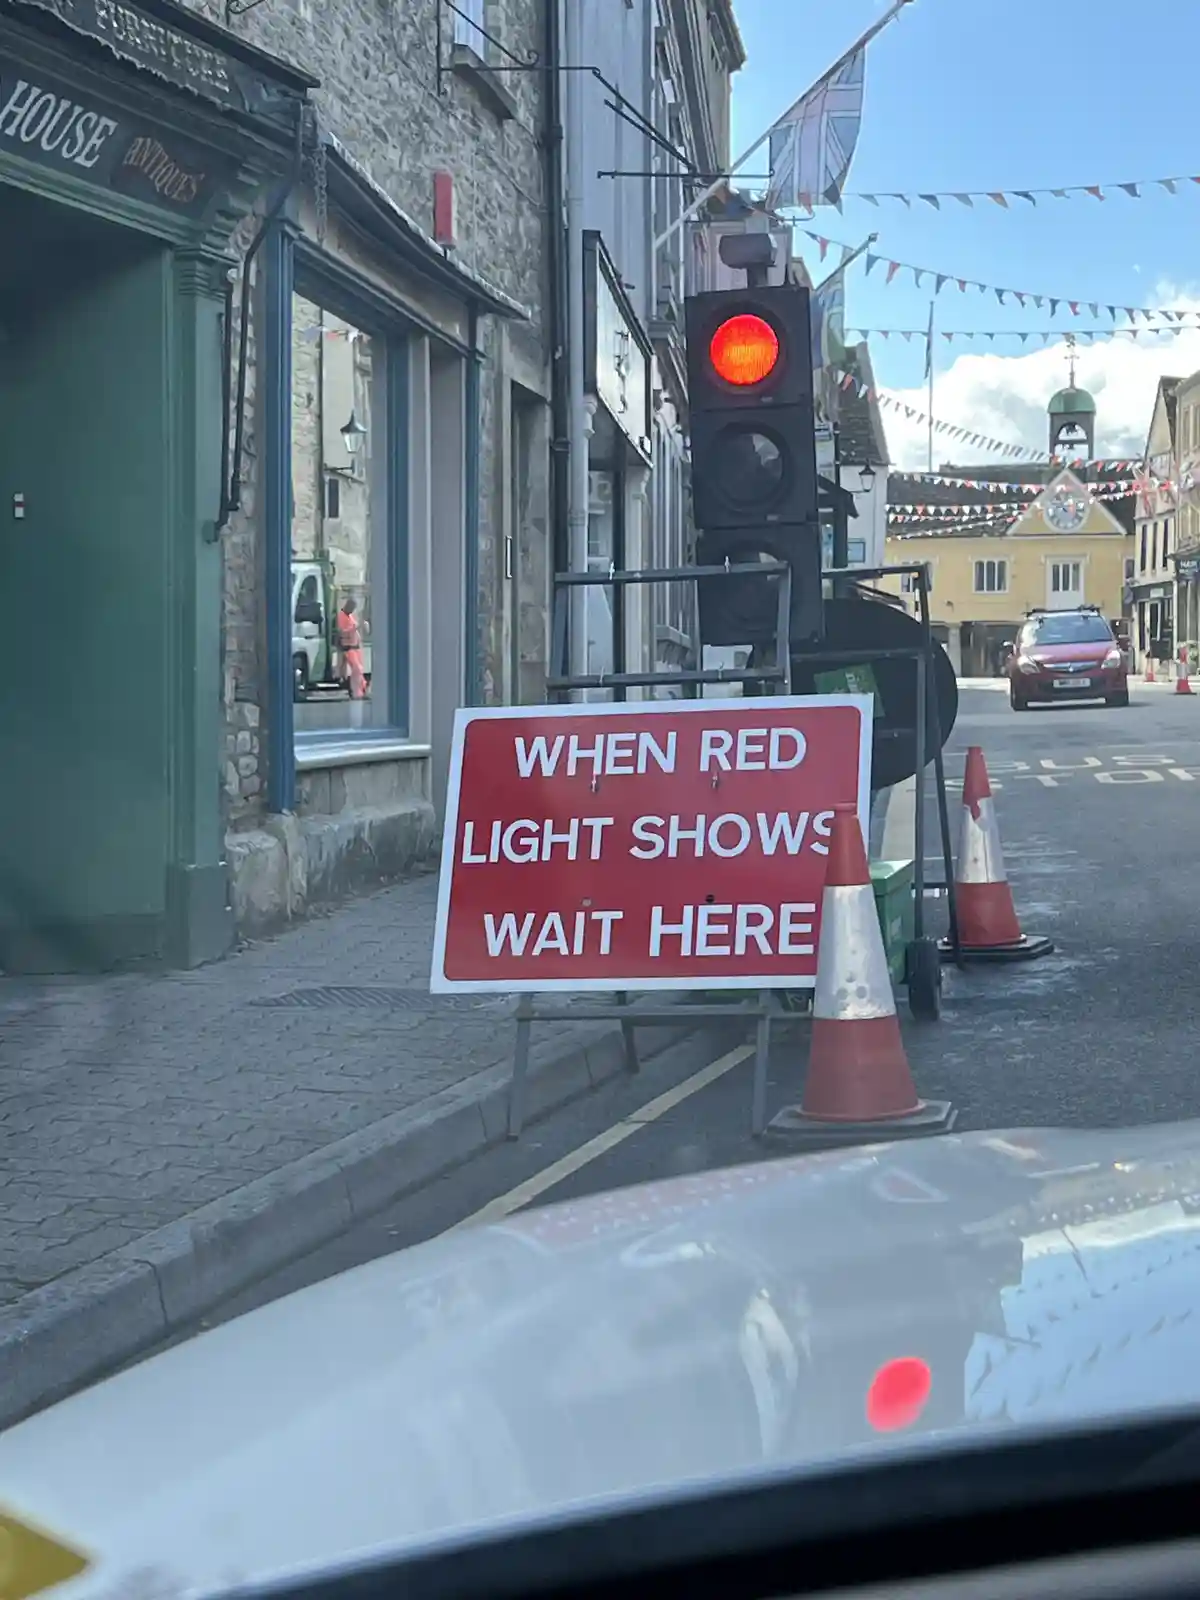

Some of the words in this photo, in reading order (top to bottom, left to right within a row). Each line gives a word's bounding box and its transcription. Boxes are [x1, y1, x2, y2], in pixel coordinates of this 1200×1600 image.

[0, 79, 119, 168] HOUSE
[514, 731, 678, 779] WHEN
[699, 727, 807, 773] RED
[461, 817, 614, 864] LIGHT
[628, 811, 835, 859] SHOWS
[483, 911, 624, 958] WAIT
[649, 903, 817, 957] HERE
